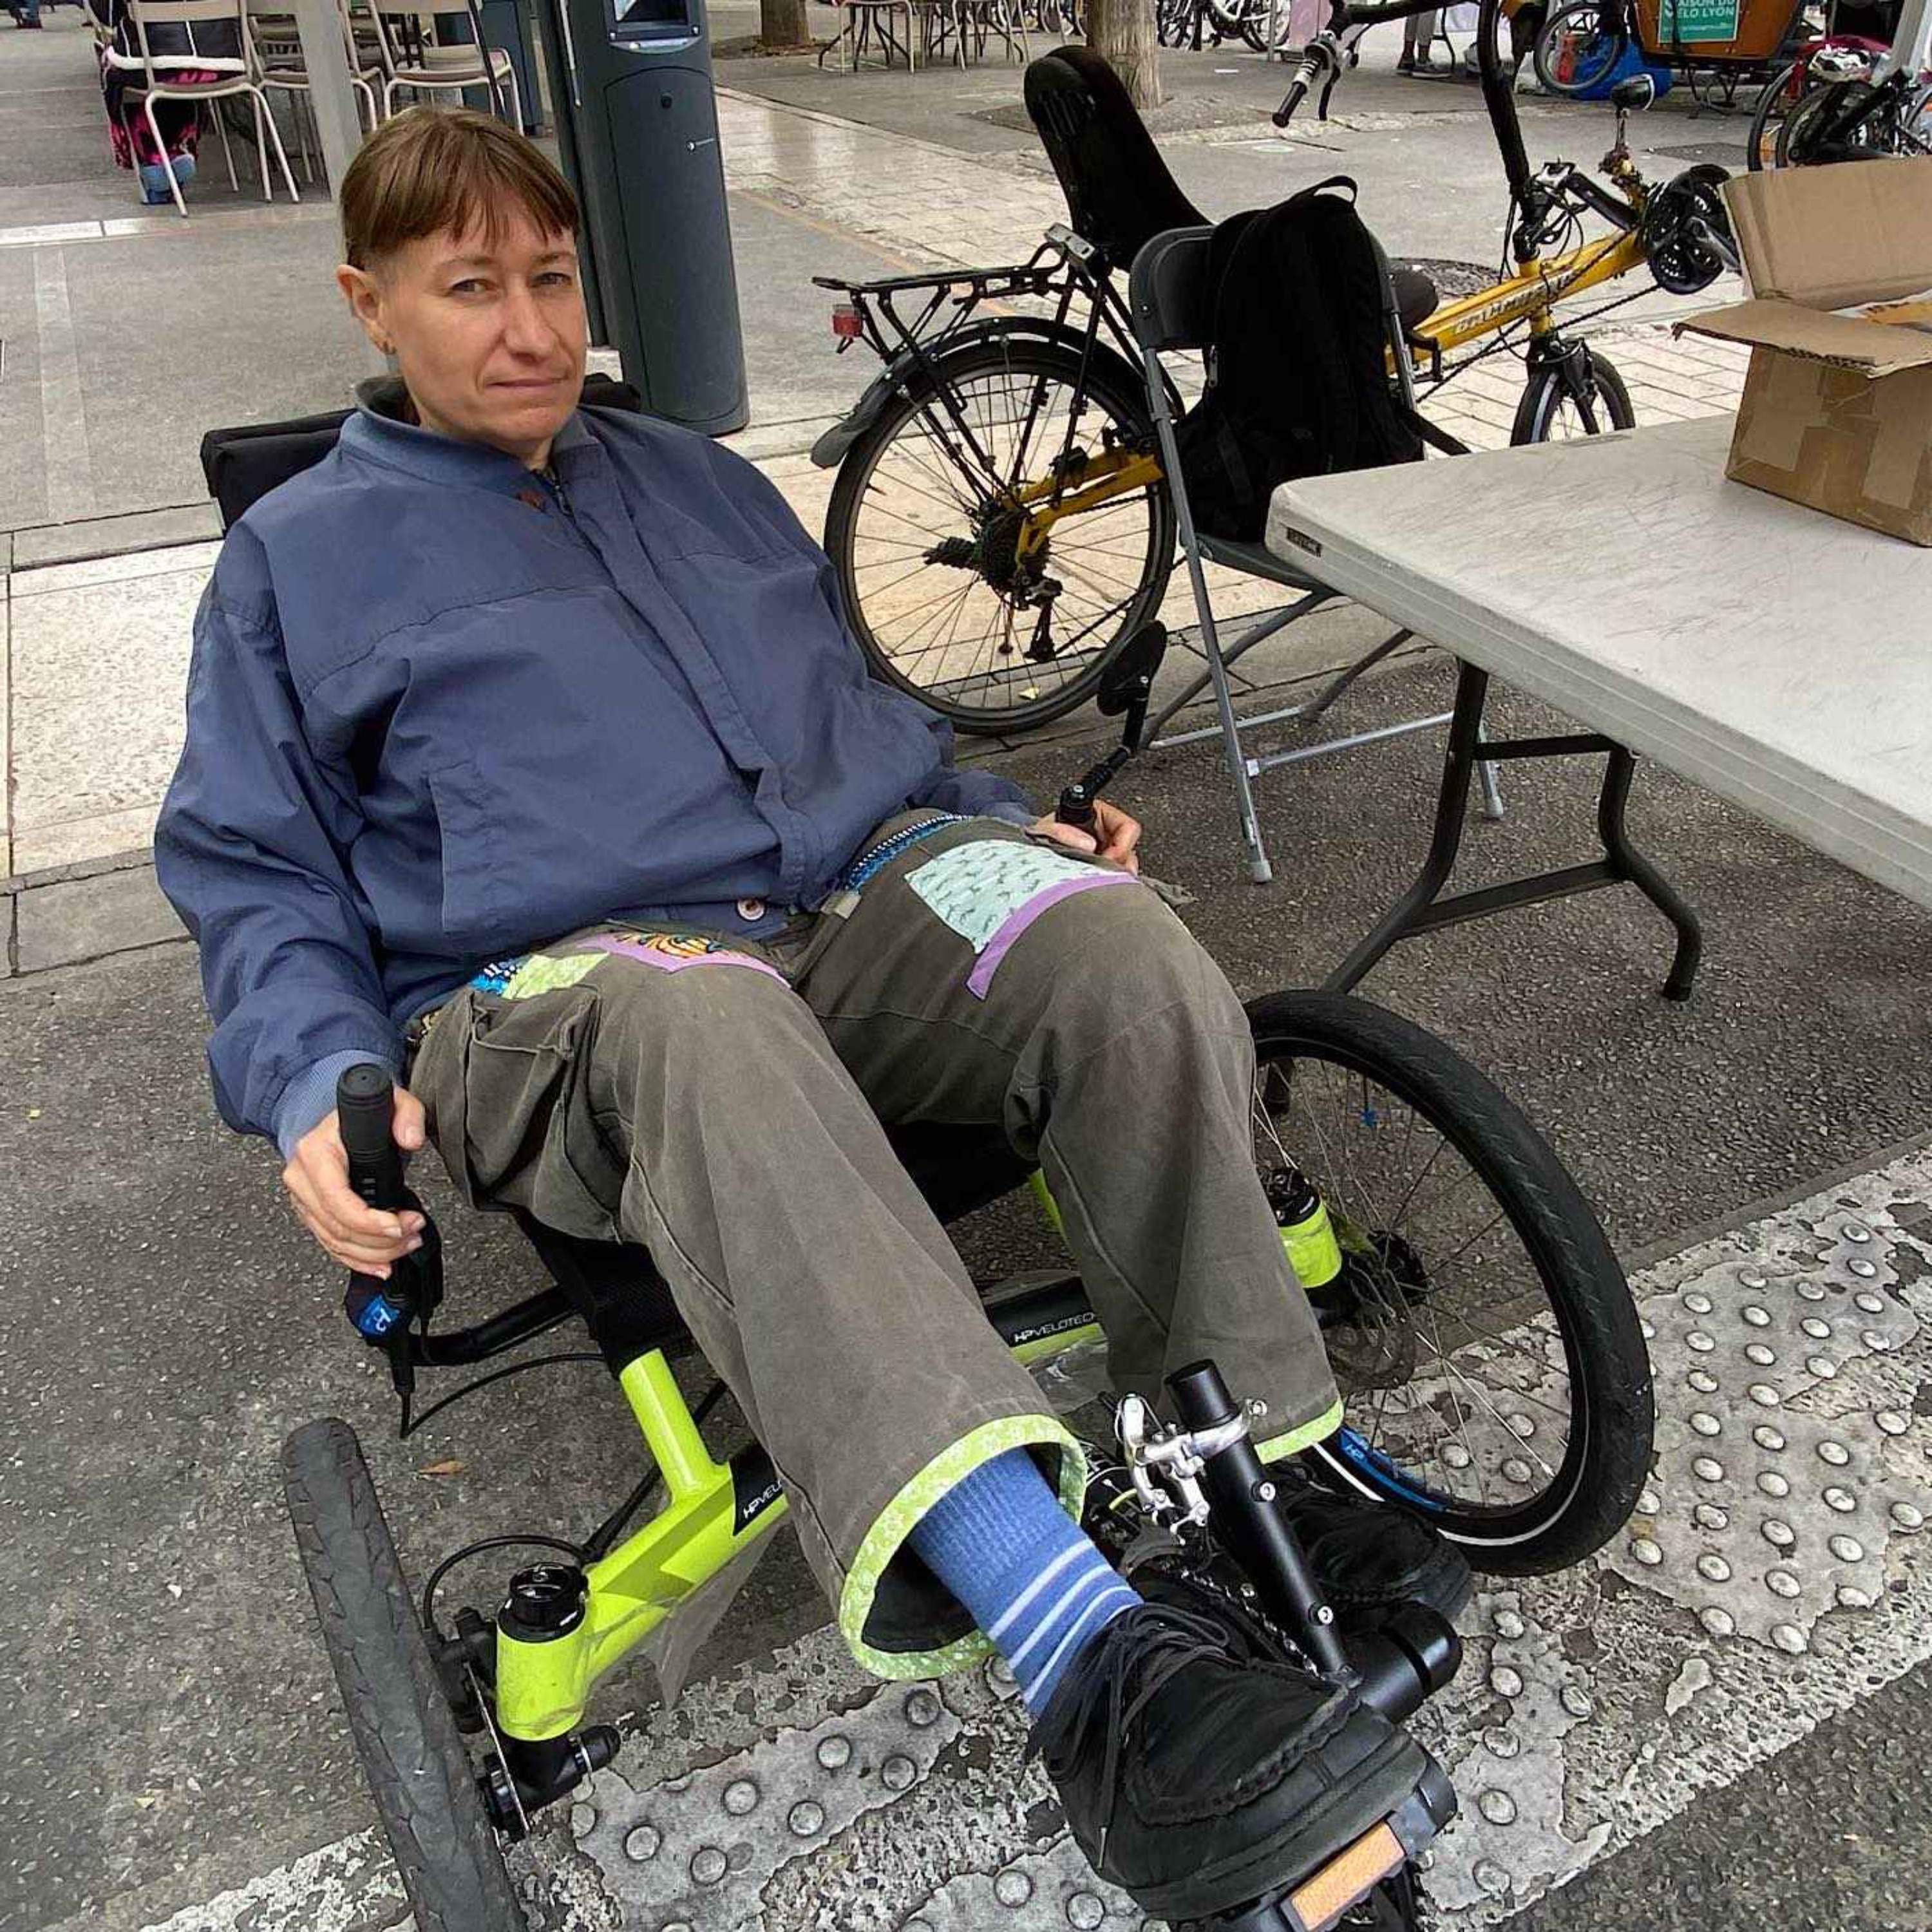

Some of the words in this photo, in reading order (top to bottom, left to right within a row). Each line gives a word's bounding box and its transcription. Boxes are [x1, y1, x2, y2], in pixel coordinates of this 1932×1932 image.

[1676, 8, 1699, 19] ELO
[1702, 6, 1734, 18] LYON
[1013, 1312, 1095, 1343] HPVELOTEC
[743, 1479, 782, 1519] HPVEL
